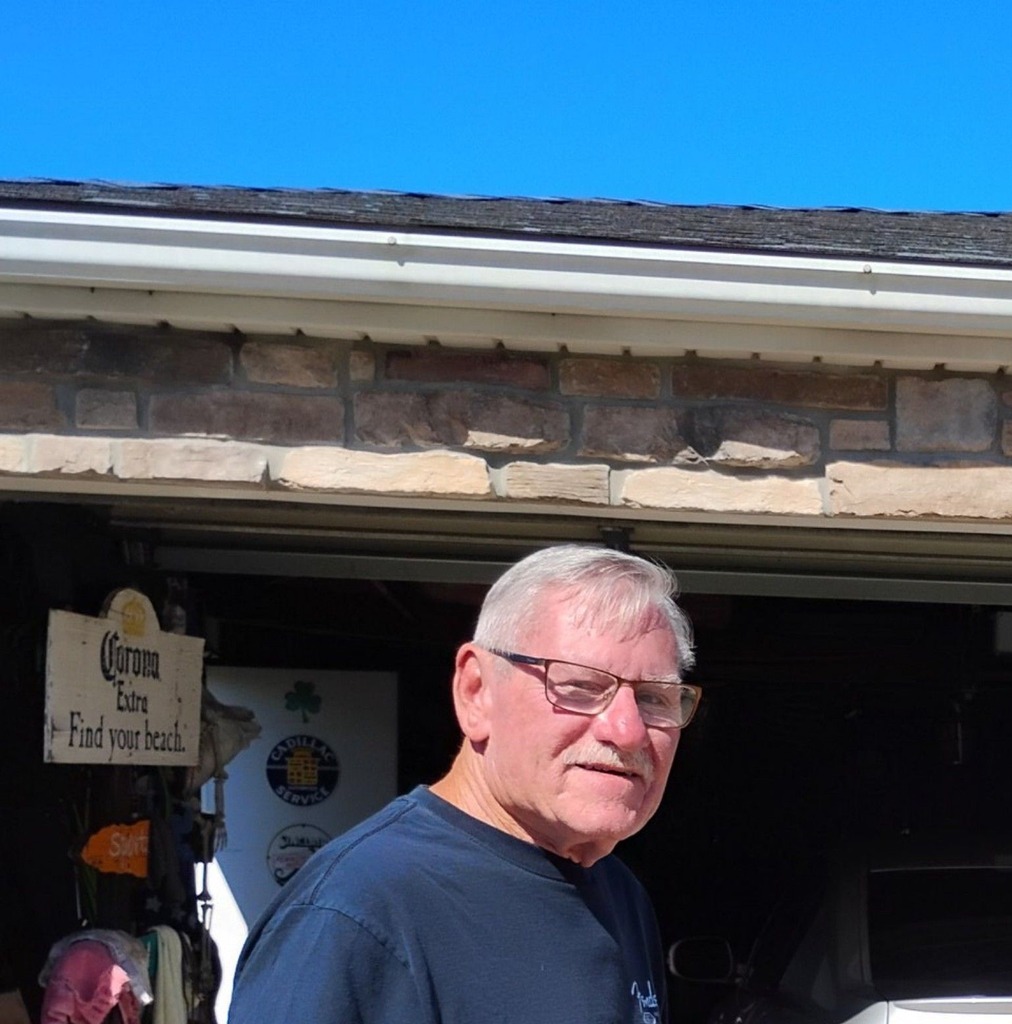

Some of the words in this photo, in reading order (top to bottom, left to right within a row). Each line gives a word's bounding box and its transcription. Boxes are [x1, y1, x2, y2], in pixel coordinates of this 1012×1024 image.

[100, 630, 161, 682] Corona
[116, 680, 149, 713] Extra
[68, 711, 104, 749] Find
[108, 728, 141, 761] your
[144, 718, 186, 752] beach.
[270, 735, 335, 762] CADILLAC
[275, 785, 331, 806] SERVICE
